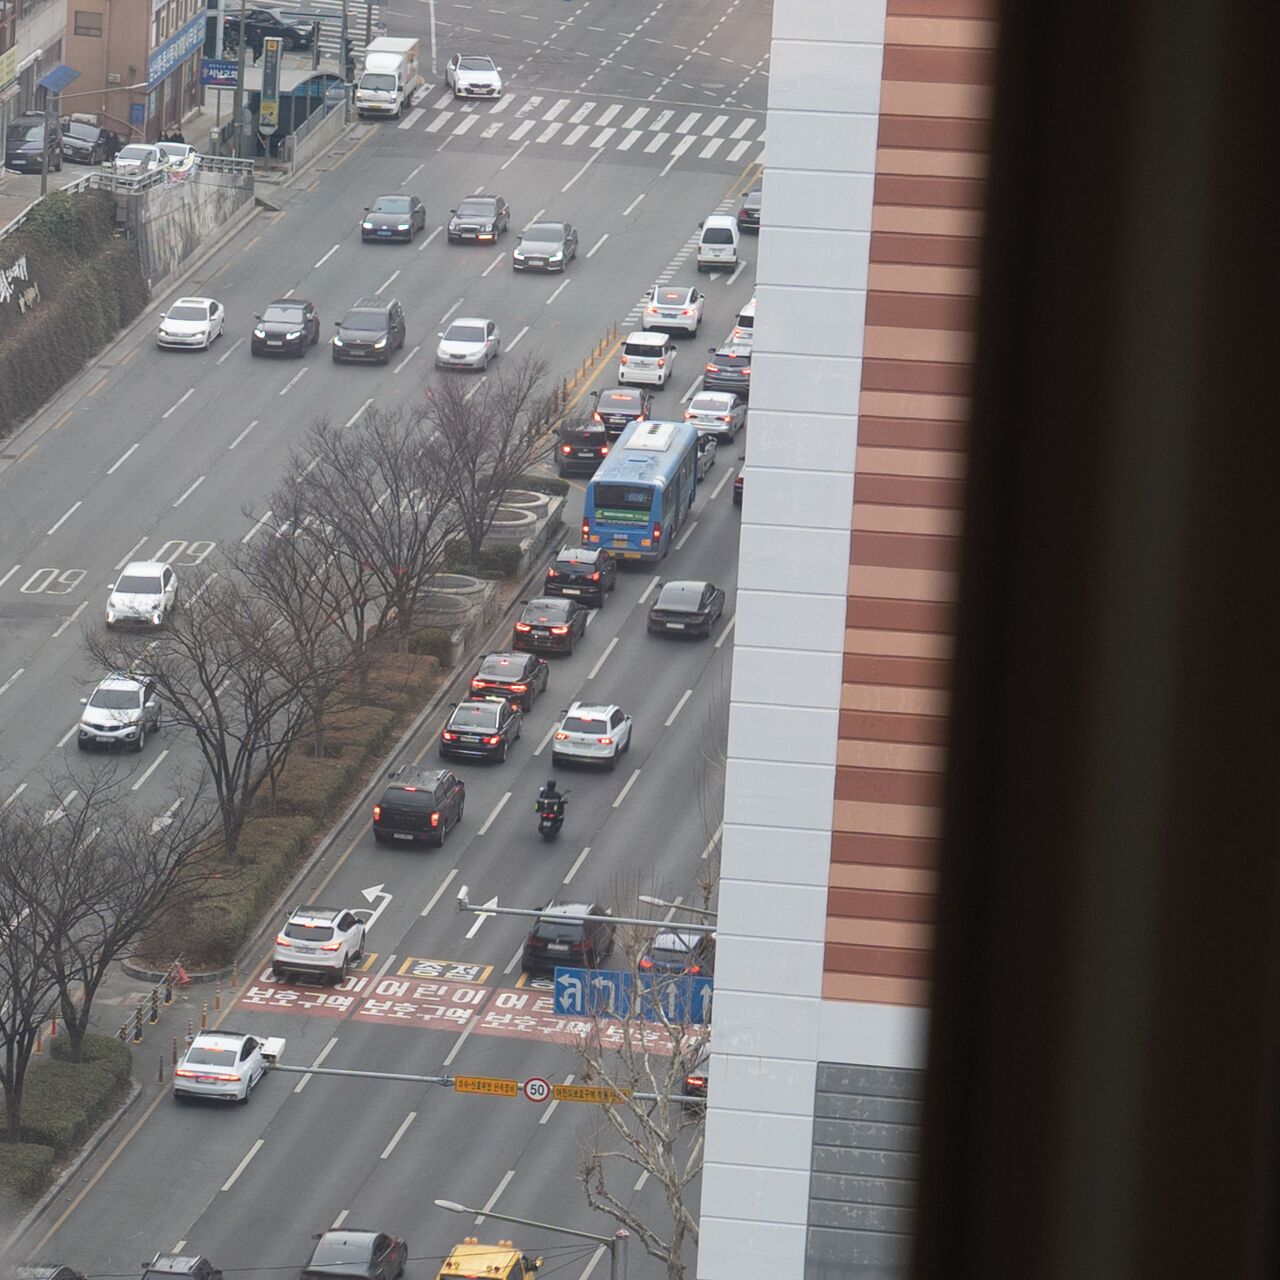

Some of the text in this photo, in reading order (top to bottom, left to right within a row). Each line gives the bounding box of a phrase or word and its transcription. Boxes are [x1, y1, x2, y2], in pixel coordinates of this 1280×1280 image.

[20, 568, 88, 595] 60
[242, 986, 355, 1012] 보호구역
[375, 980, 487, 1005] 어린이
[360, 998, 474, 1025] 보호구역
[530, 1084, 544, 1096] 50
